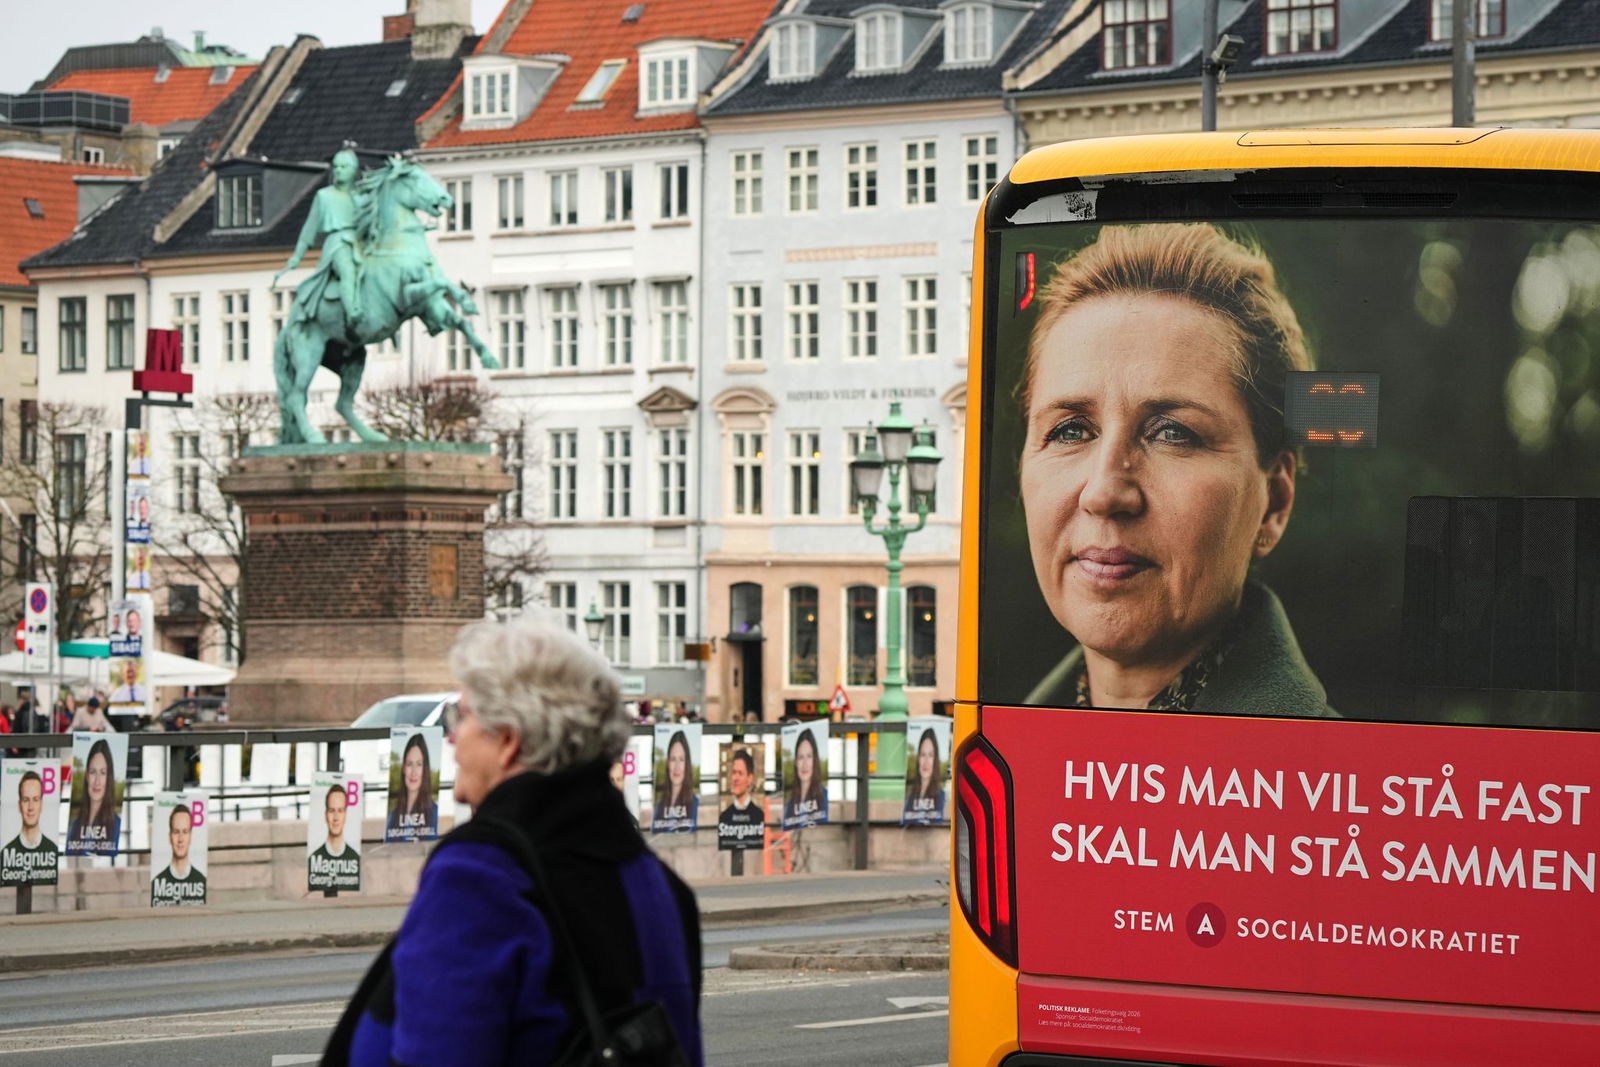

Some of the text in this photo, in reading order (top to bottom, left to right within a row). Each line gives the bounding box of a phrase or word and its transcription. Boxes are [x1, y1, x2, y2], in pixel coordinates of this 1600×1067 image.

[150, 328, 182, 372] M
[624, 751, 635, 775] B
[42, 767, 56, 794] B
[347, 781, 358, 806] B
[1064, 760, 1591, 826] HVIS MAN VIL STÅ FAST
[192, 801, 204, 827] B
[399, 813, 426, 827] LINEA
[80, 825, 107, 840] LINEA
[719, 822, 764, 839] Storgaard
[3, 848, 56, 870] Magnus
[311, 854, 358, 876] Magnus
[1050, 822, 1596, 893] SKAL MAN STÅ SAMMEN
[2, 868, 56, 882] Georg Jensen
[310, 873, 333, 887] Georg
[154, 878, 204, 900] Magnus
[1114, 909, 1520, 955] STEM A SOCIALDEMOKRATIET
